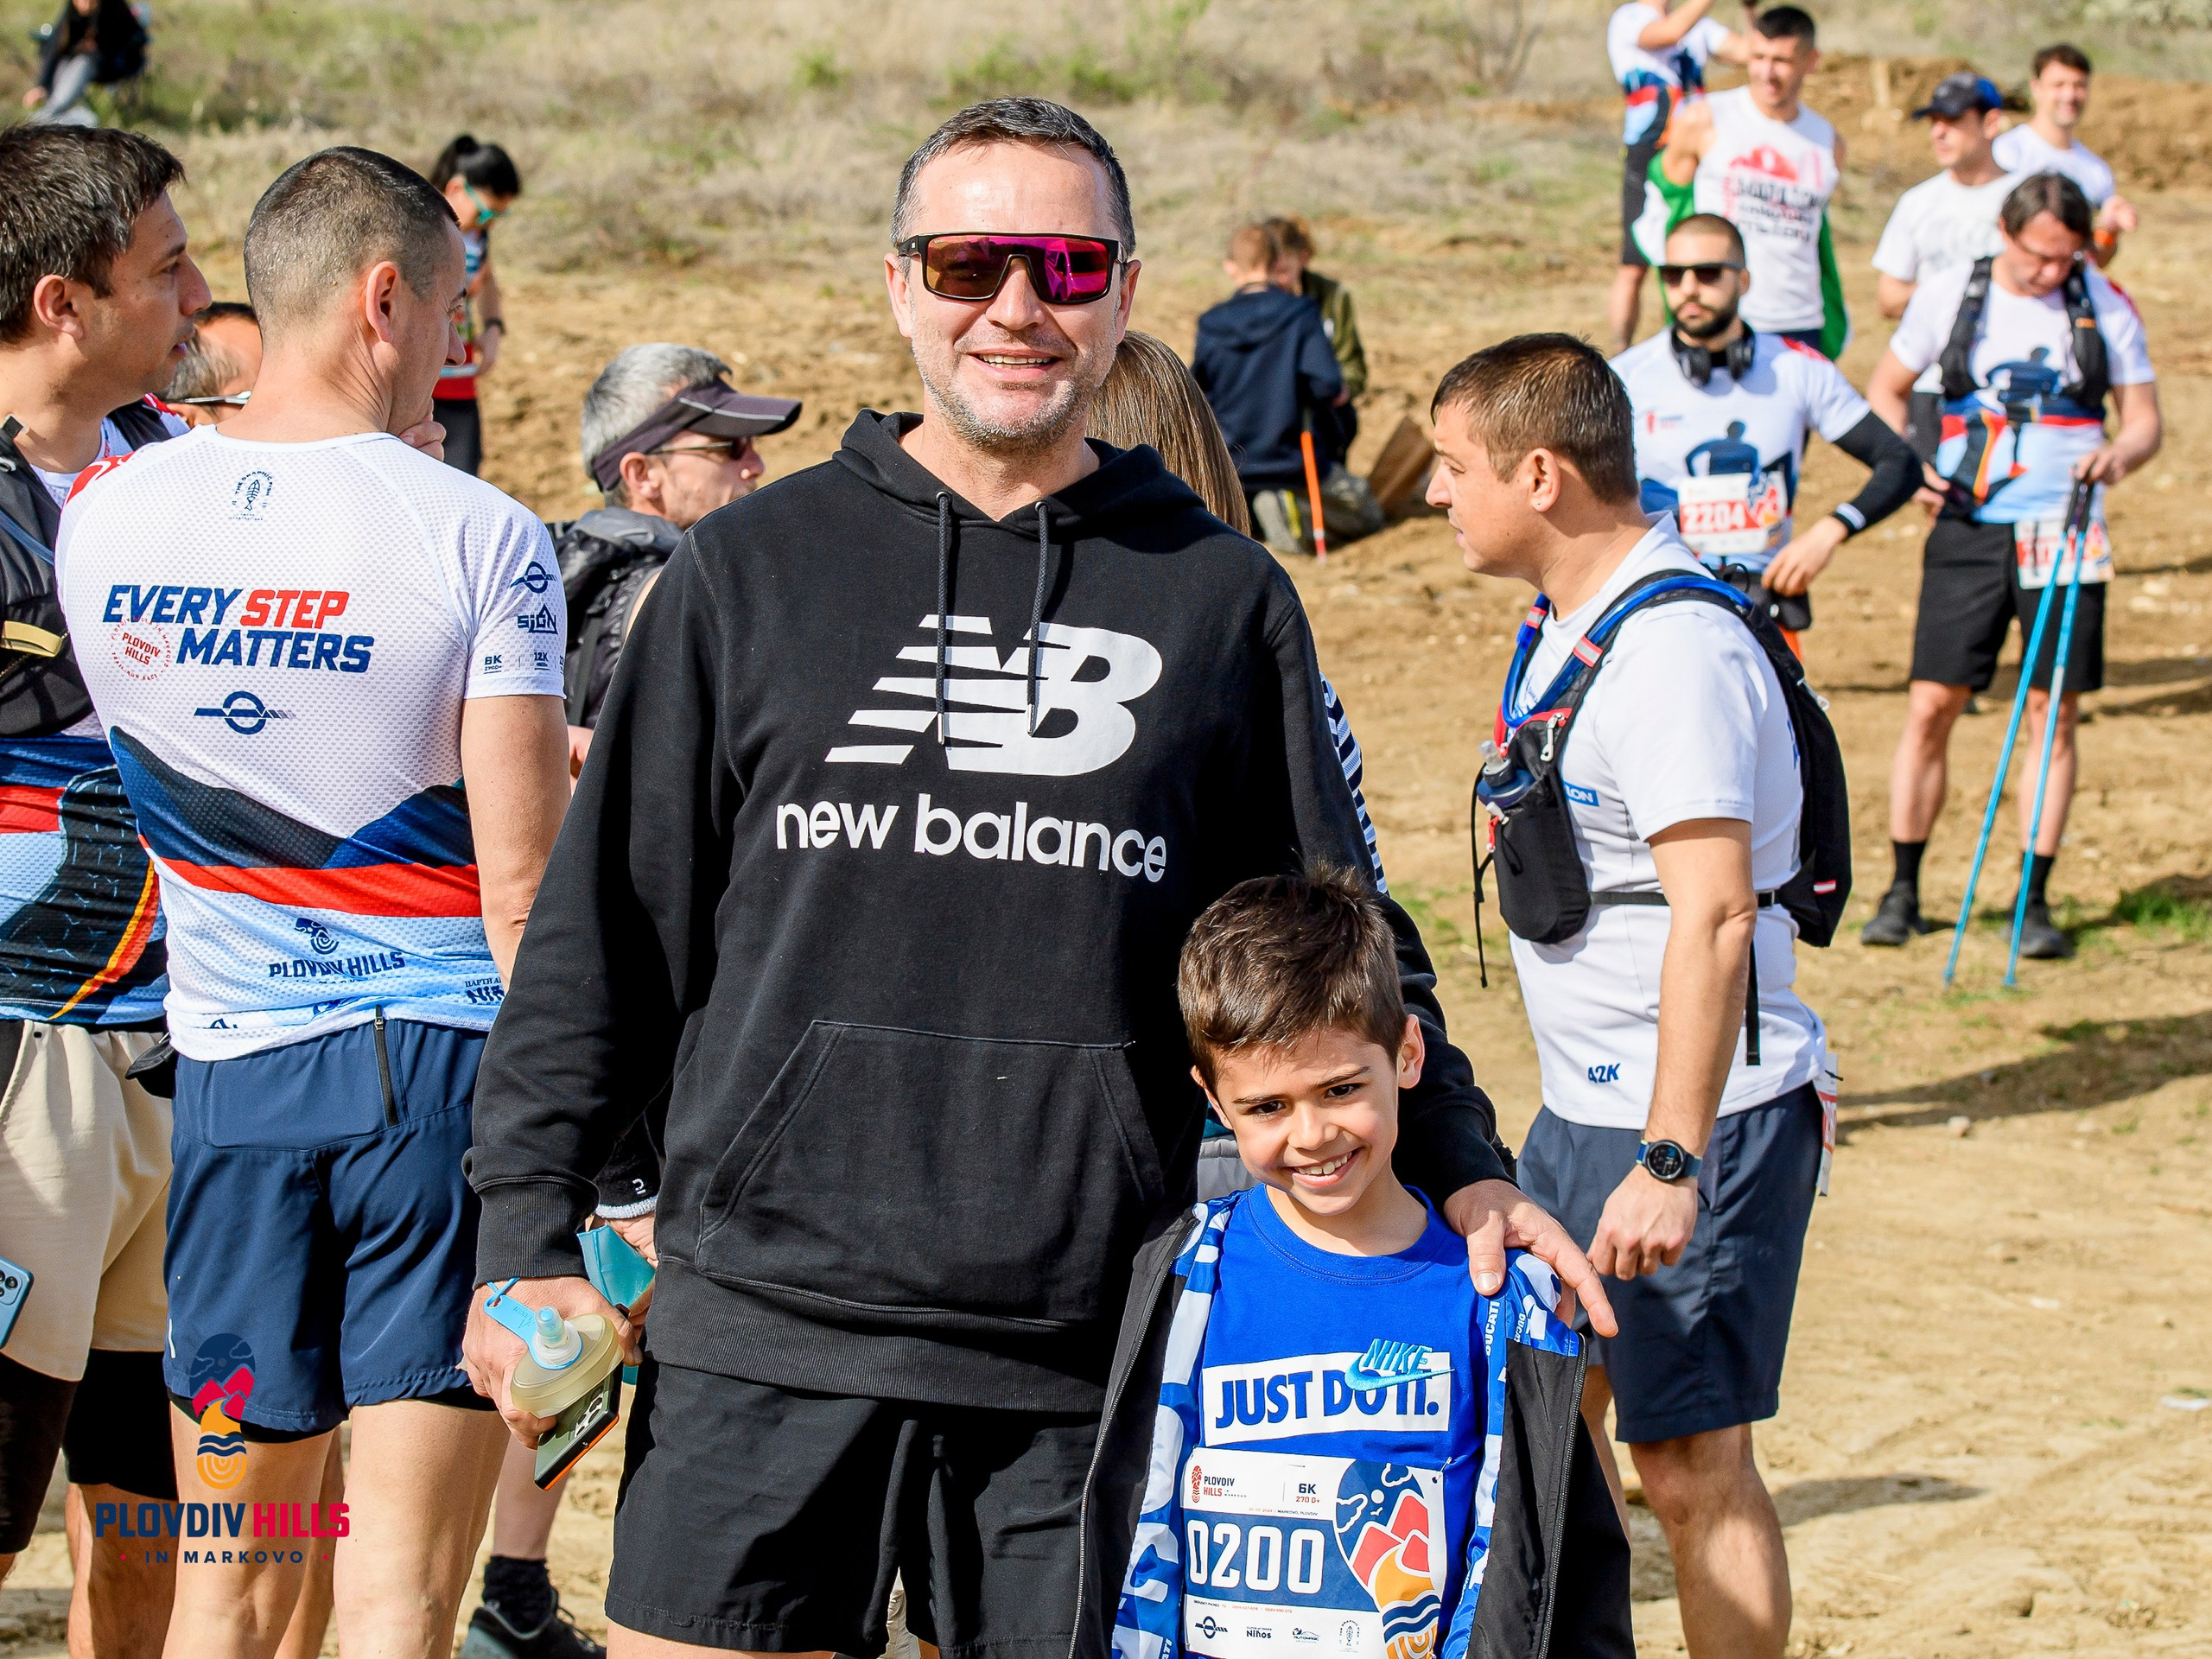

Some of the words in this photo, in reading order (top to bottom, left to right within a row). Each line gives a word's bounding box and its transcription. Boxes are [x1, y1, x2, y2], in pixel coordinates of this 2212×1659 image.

[1686, 500, 1746, 532] 2204
[103, 585, 244, 625] EVERY
[240, 589, 350, 629] STEP
[122, 632, 161, 658] PLOVDIV
[125, 646, 151, 665] HILLS
[175, 628, 375, 673] MATTERS
[534, 652, 549, 662] 12K
[485, 655, 502, 665] 6K
[777, 801, 899, 849] new
[914, 793, 1166, 882] balance
[346, 951, 405, 977] HILLS
[1588, 1063, 1621, 1084] 42K
[1485, 1300, 1500, 1357] DUCATI
[1363, 1338, 1433, 1374] NIKE
[1216, 1371, 1313, 1428] JUST
[1323, 1370, 1387, 1417] DO
[1204, 1476, 1235, 1486] PLOVDIV
[1204, 1487, 1223, 1497] HILLS
[1299, 1483, 1317, 1495] 6K
[1187, 1519, 1325, 1594] 0200
